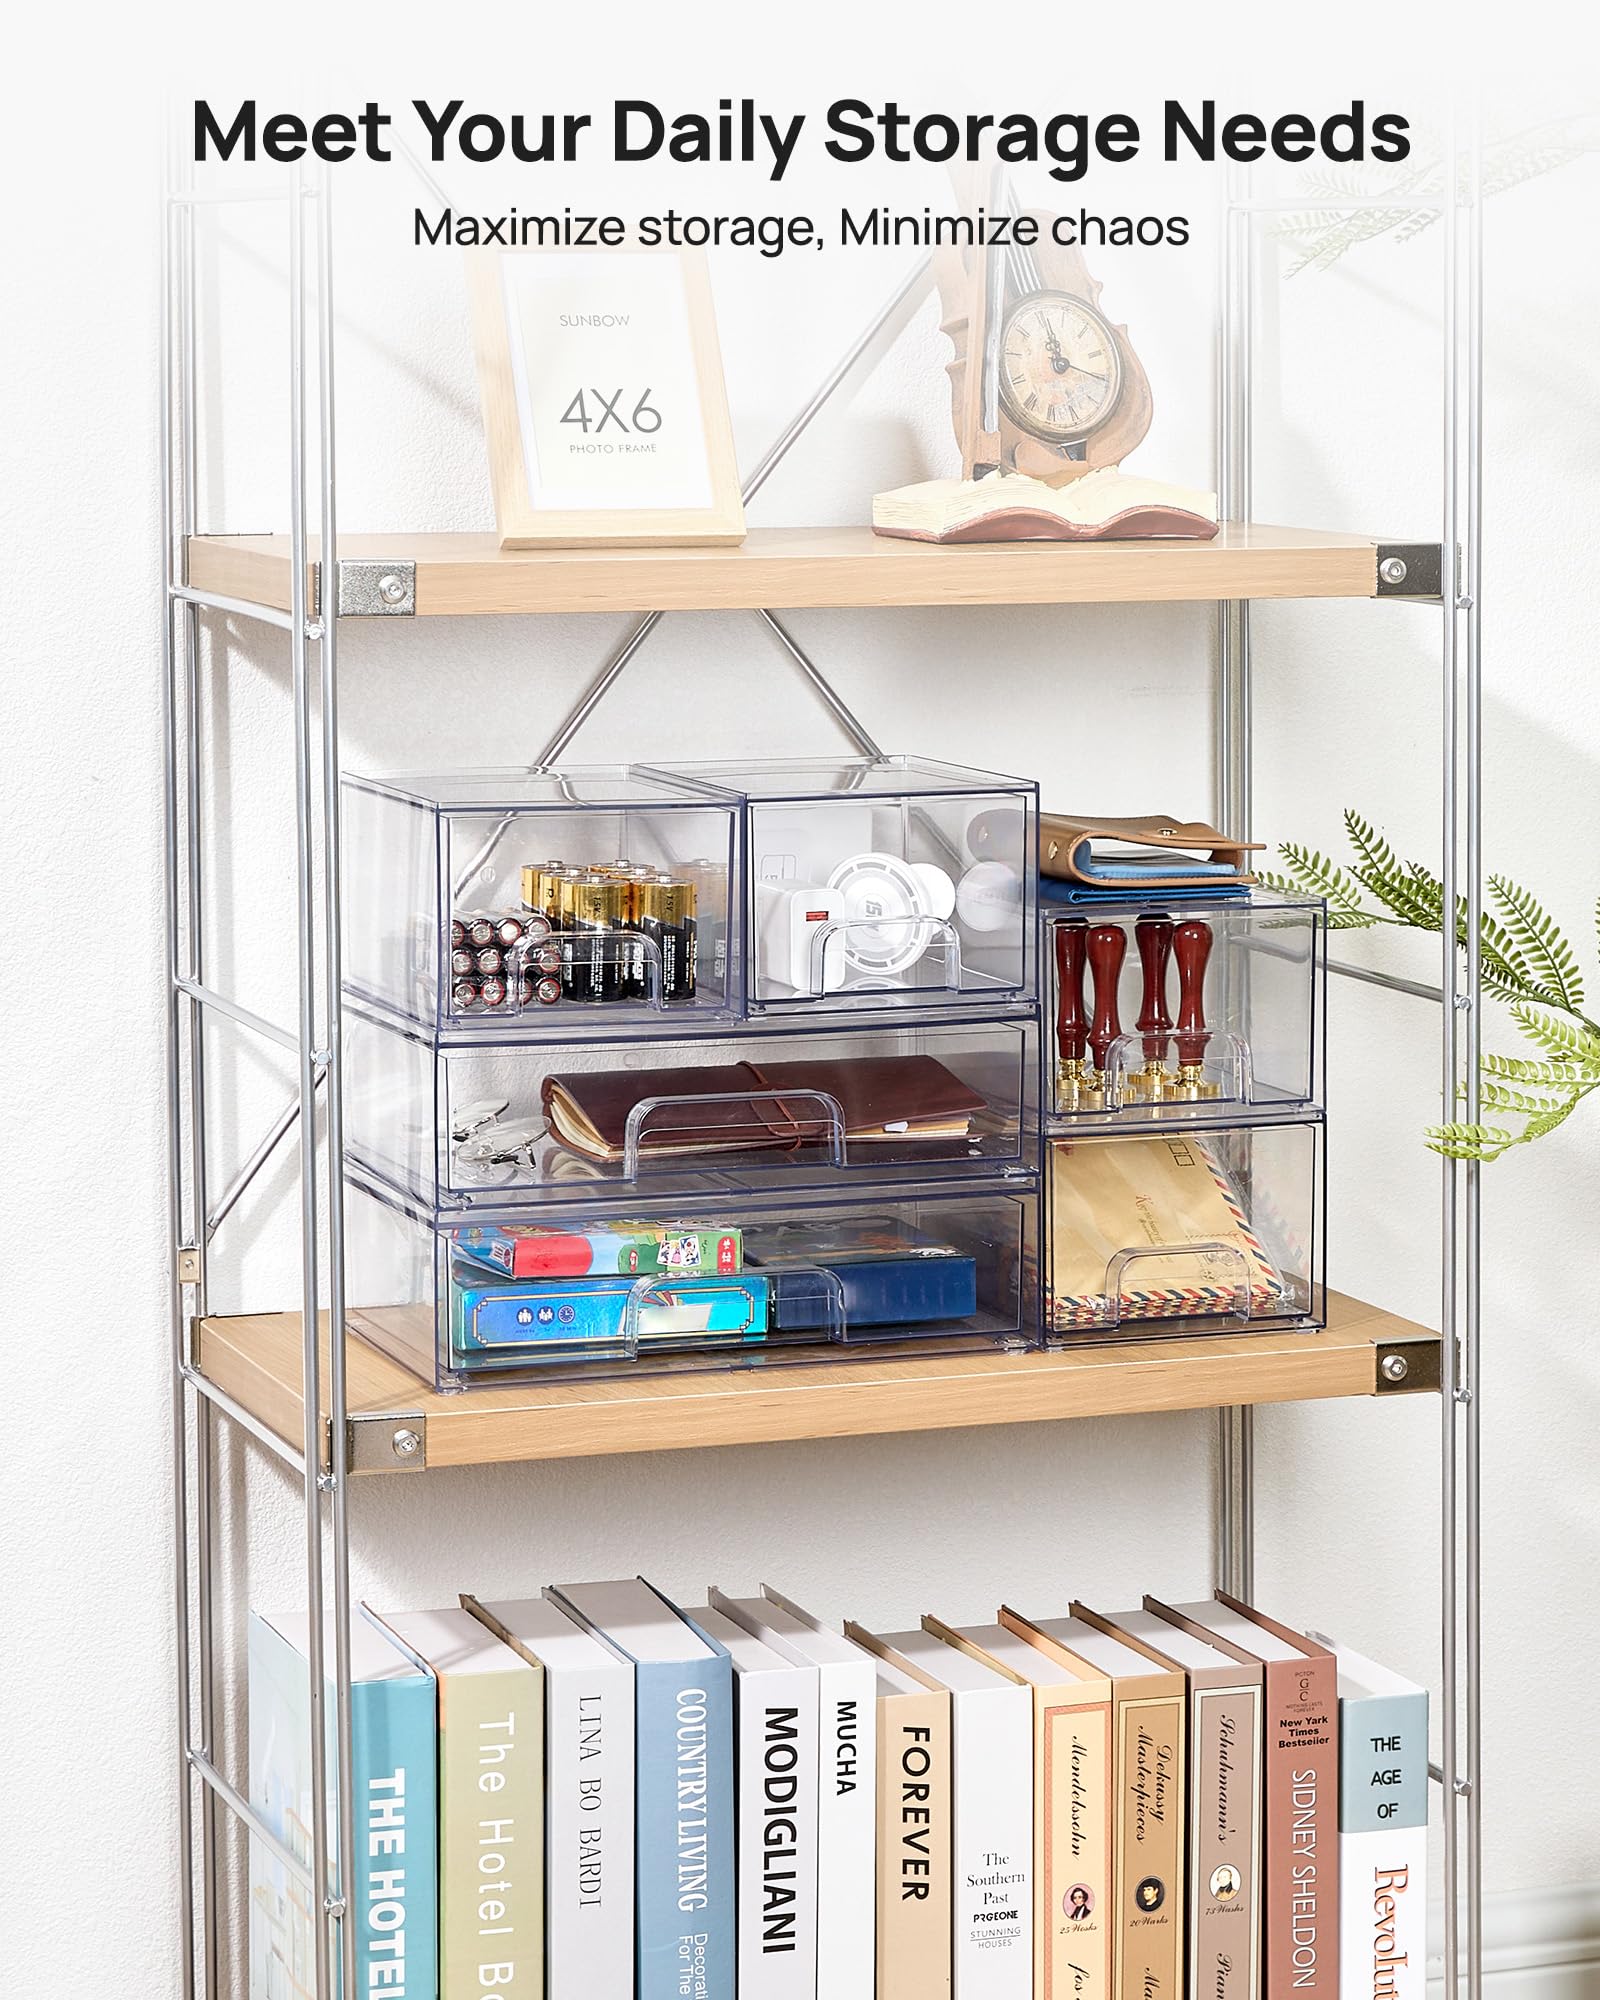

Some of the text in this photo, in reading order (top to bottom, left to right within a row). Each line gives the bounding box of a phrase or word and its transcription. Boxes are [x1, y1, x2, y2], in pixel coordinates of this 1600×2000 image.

[559, 314, 631, 327] SUNBOW
[559, 387, 663, 434] 4X6
[569, 443, 657, 454] PHOTO FRAME
[478, 1711, 515, 1793] The
[836, 1701, 857, 1796] MUCHA
[1280, 1719, 1302, 1728] New
[1289, 1728, 1319, 1737] Times
[1370, 1735, 1402, 1753] THE
[579, 1695, 602, 1907] LINA BO BARDI
[676, 1688, 708, 1912] COUNTRY LIVING
[1071, 1735, 1088, 1860] Mendelssohn
[1131, 1725, 1155, 1845] Masterpieces
[1370, 1768, 1402, 1787] AGE
[762, 1707, 799, 1954] MODIGLIANI
[901, 1726, 931, 1901] FOREVER
[1377, 1802, 1399, 1819] OF
[368, 1768, 406, 2000] THE HOTEL
[478, 1818, 515, 1936] Hotel
[966, 1871, 1025, 1888] Southern
[983, 1853, 1010, 1866] The
[1292, 1769, 1316, 1988] SIDNEY SHELDON
[984, 1892, 1009, 1905] Past
[970, 1926, 1021, 1939] STUNNING
[978, 1938, 1013, 1949] HOUSES
[1372, 1863, 1409, 2000] Revolut
[679, 1935, 693, 1995] For The
[694, 1933, 708, 2000] Decorati
